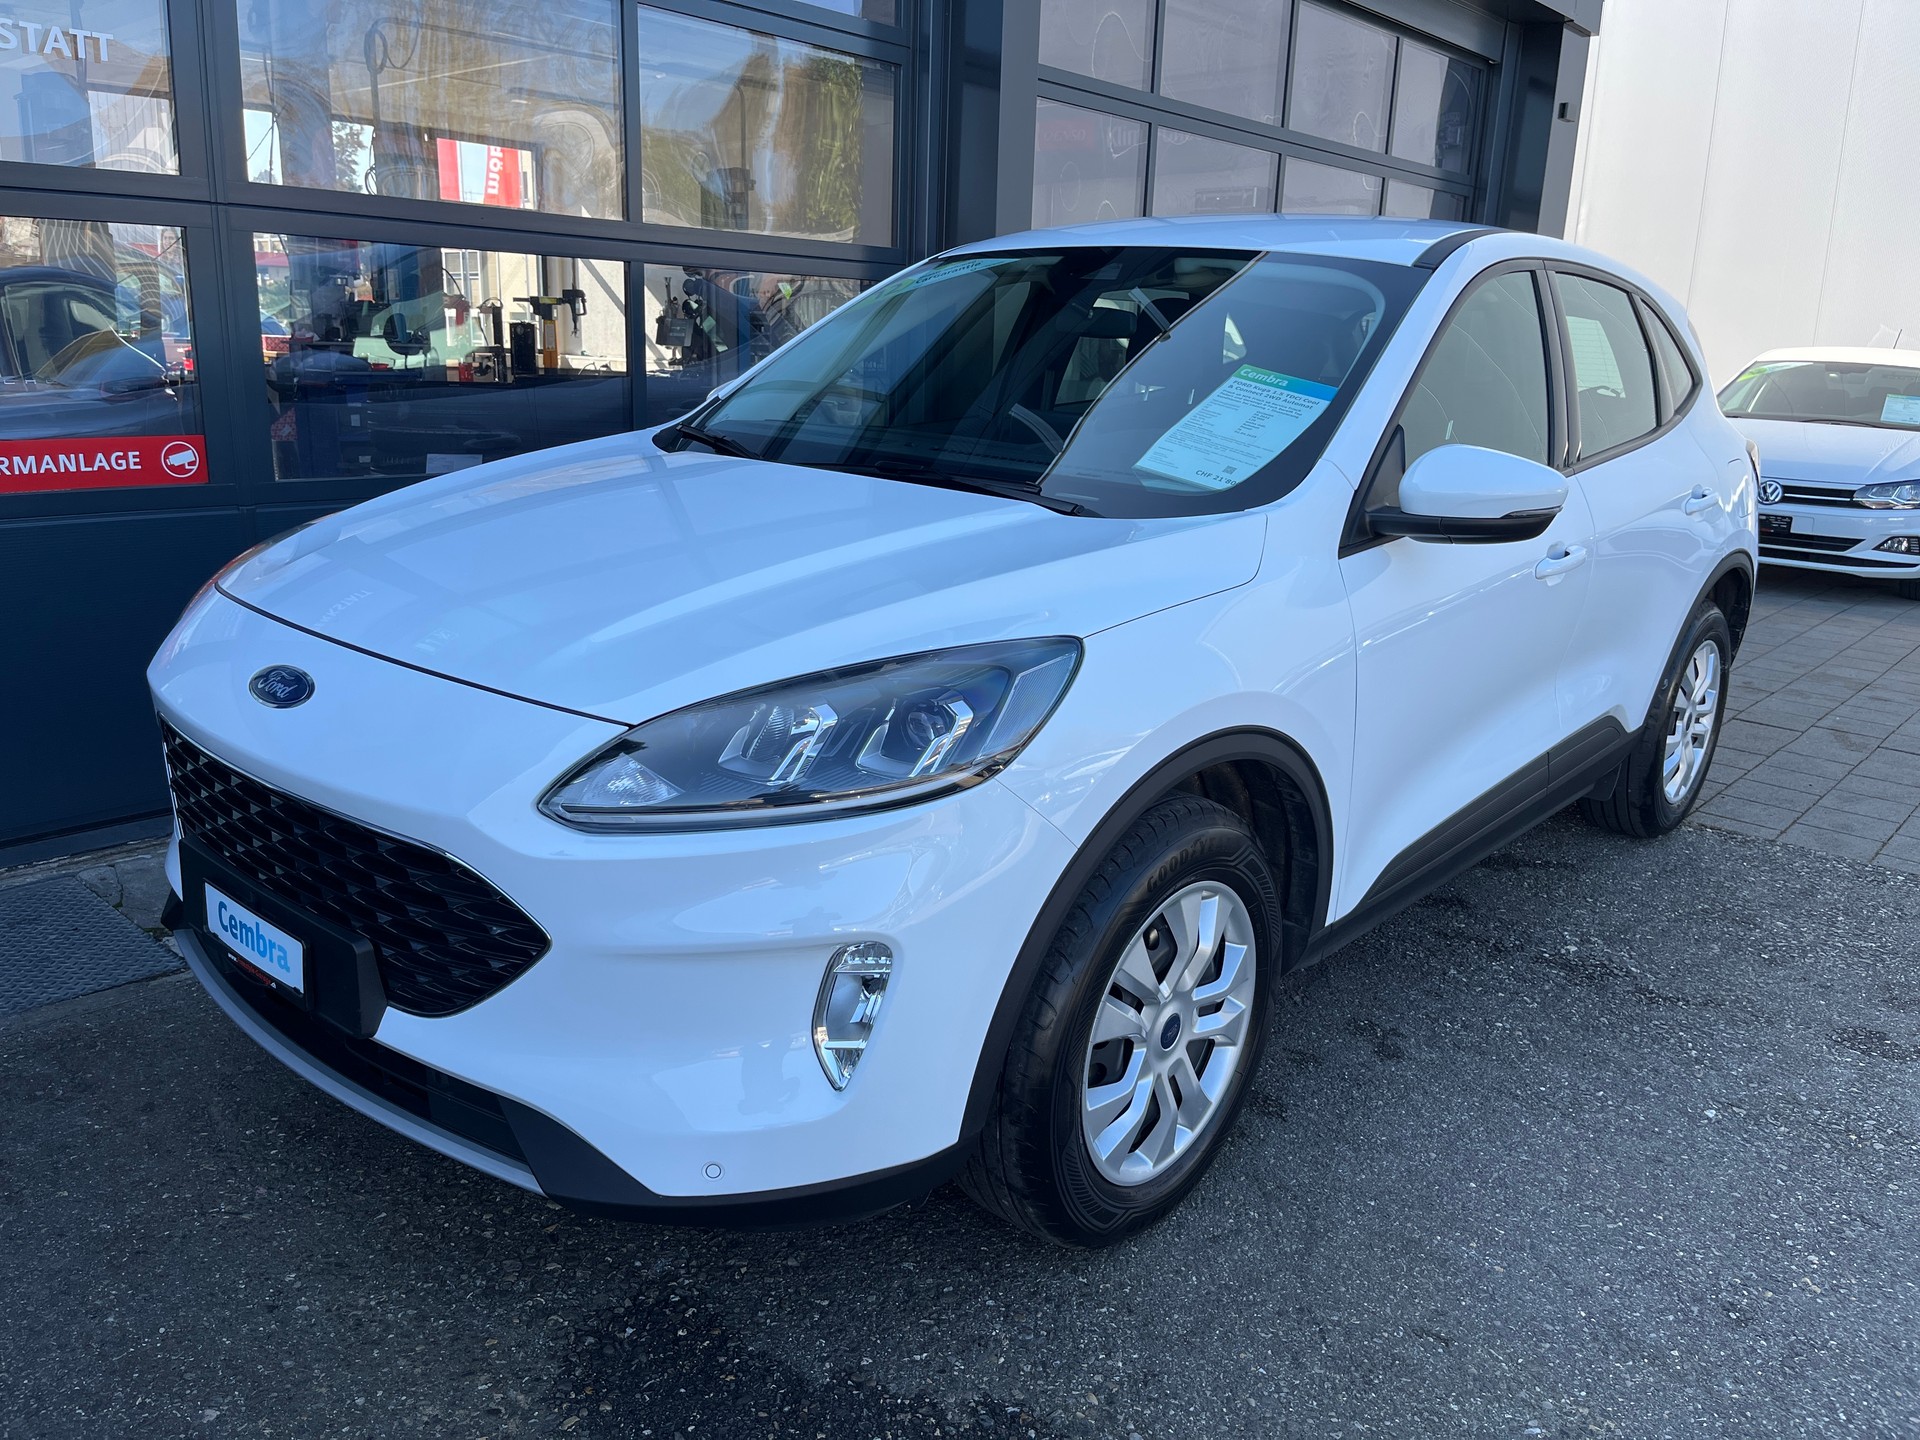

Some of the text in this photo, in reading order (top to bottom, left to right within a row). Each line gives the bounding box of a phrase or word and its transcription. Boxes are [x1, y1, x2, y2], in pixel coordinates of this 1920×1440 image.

[0, 17, 114, 62] STATT
[1240, 368, 1289, 387] Cembra
[1232, 380, 1253, 389] FORD
[1253, 385, 1271, 394] Kuga
[1302, 398, 1320, 406] Cool
[1235, 385, 1264, 397] Connect
[1264, 393, 1282, 402] 2WD
[1282, 398, 1314, 410] Automat
[1195, 469, 1240, 486] CHF 21'80
[257, 670, 298, 698] Ford
[217, 900, 291, 973] Cembra
